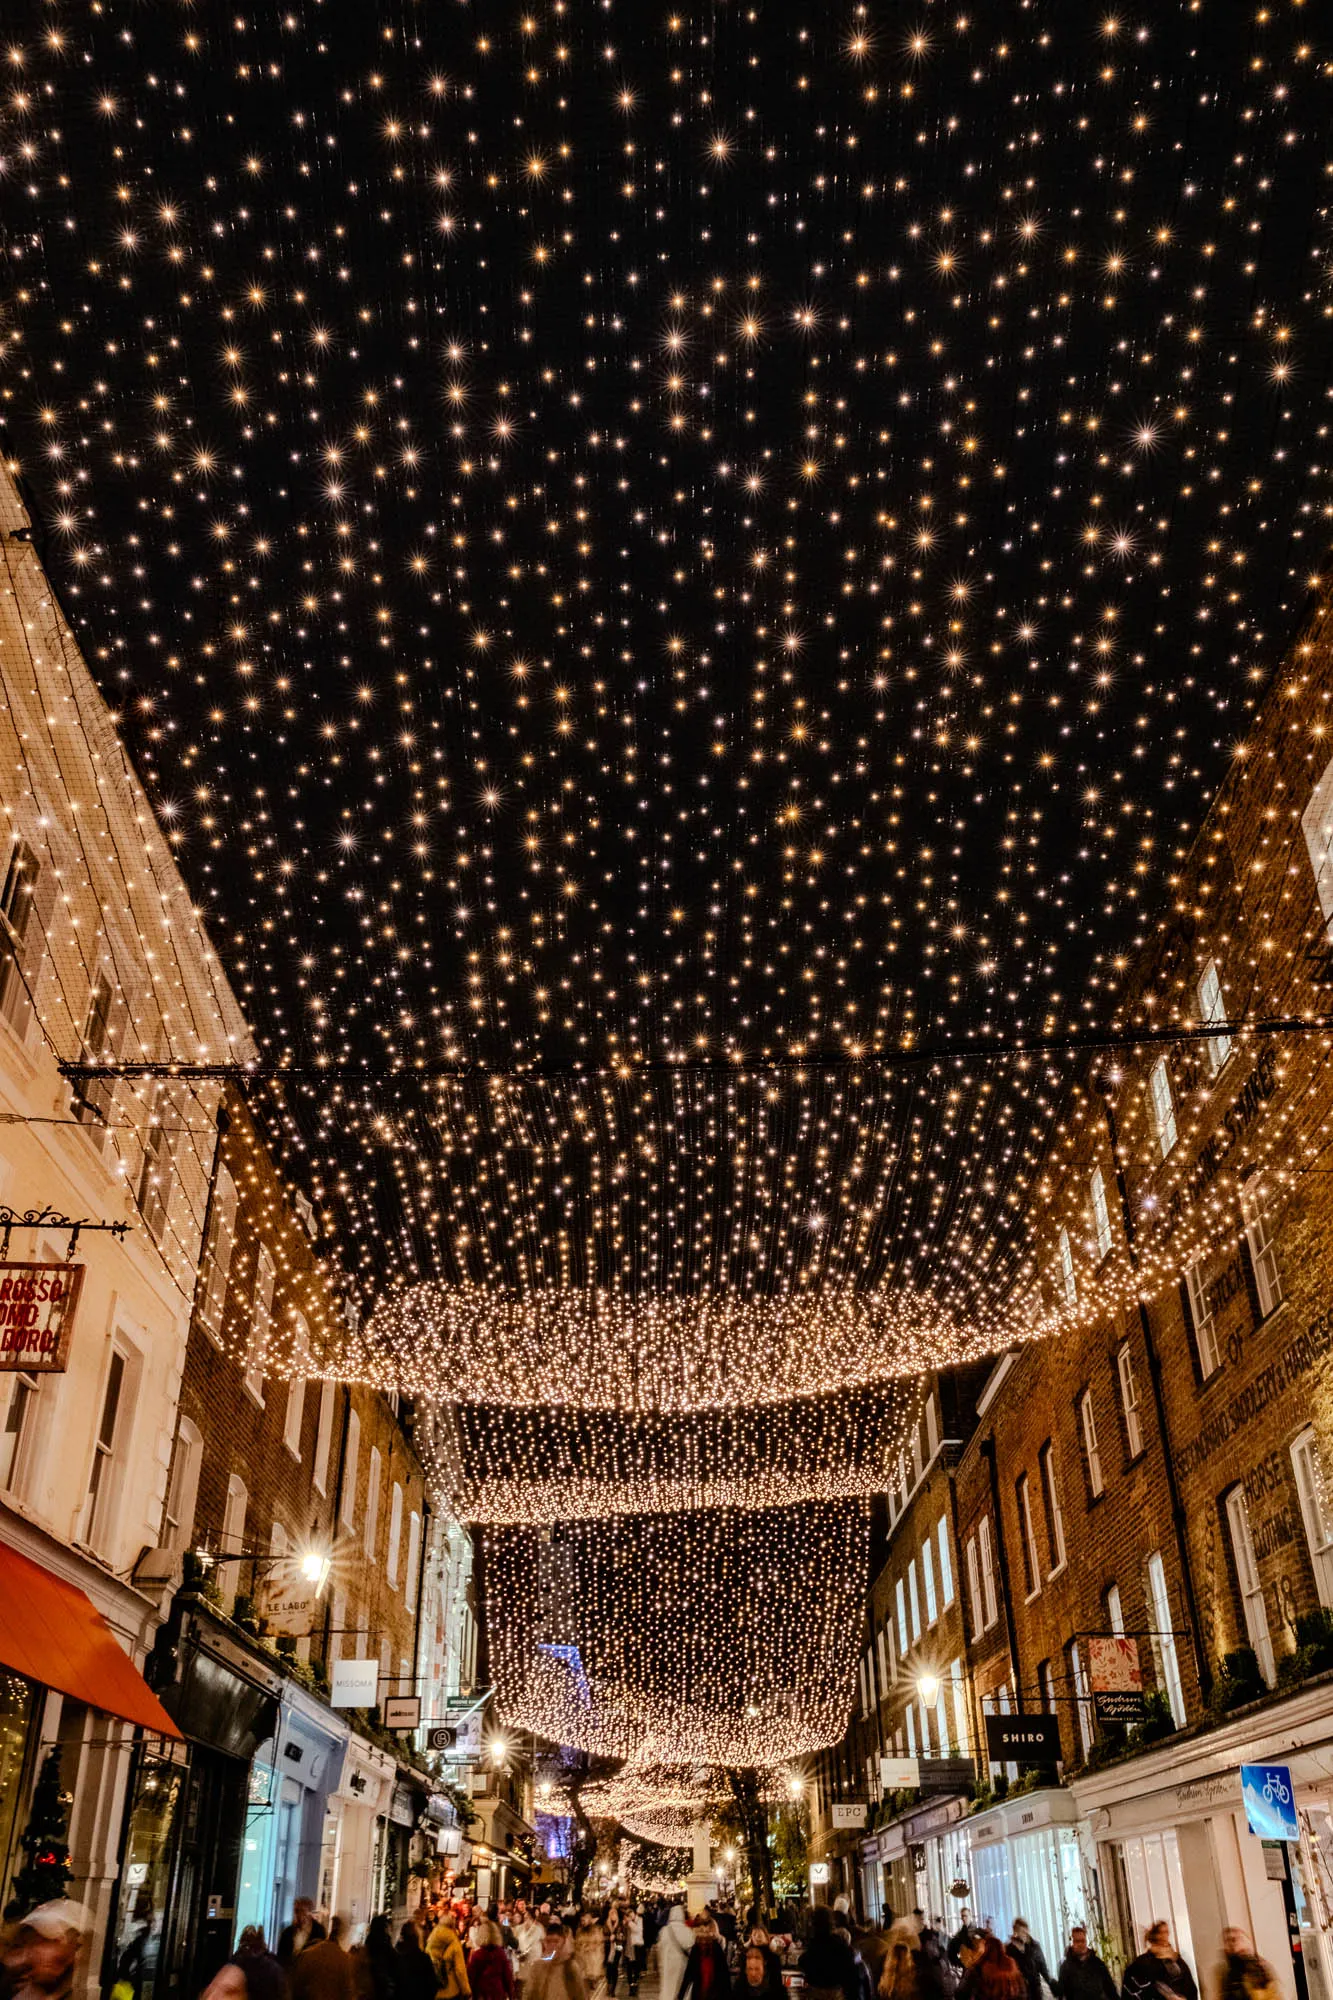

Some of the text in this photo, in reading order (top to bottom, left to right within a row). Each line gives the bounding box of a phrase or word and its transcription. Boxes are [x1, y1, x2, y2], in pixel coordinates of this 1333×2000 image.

[0, 1278, 63, 1302] ROSSO
[0, 1328, 53, 1353] DORO
[1227, 1322, 1243, 1366] OF
[1240, 1450, 1283, 1508] HORSE
[268, 1603, 280, 1612] LE
[1002, 1733, 1045, 1743] SHIRO
[837, 1808, 861, 1817] EPC
